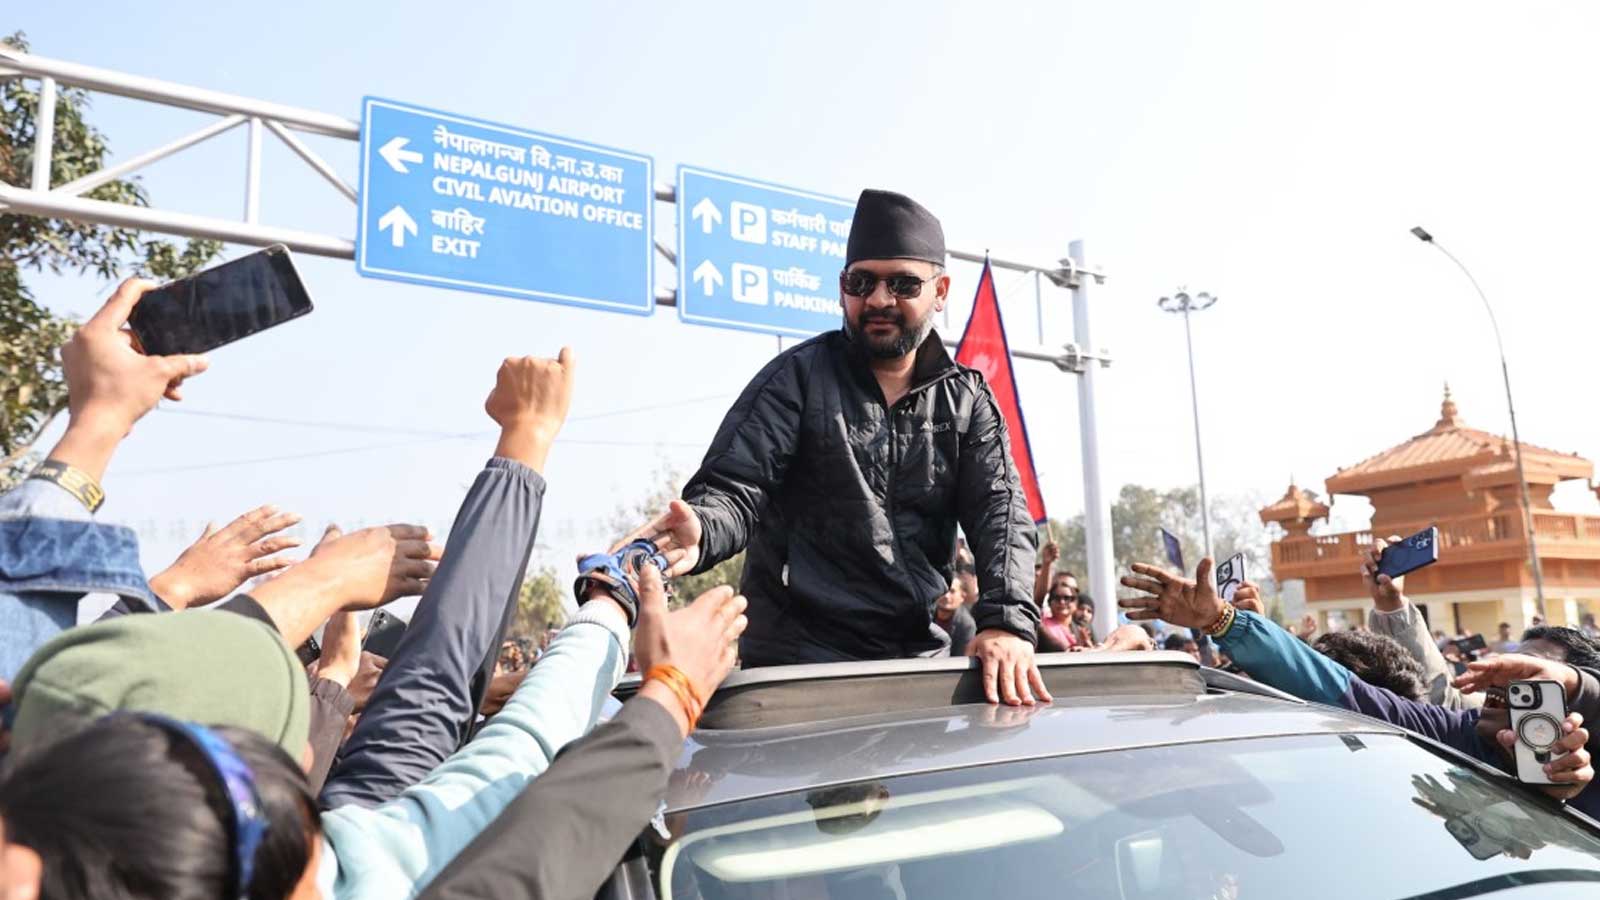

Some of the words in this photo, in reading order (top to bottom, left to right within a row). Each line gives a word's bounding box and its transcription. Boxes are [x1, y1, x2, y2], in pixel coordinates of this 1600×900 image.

[433, 152, 543, 193] NEPALGUNJ
[548, 175, 625, 205] AIRPORT
[432, 176, 484, 202] CIVIL
[488, 186, 578, 219] AVIATION
[582, 204, 643, 230] OFFICE
[431, 207, 486, 236] बाहिर
[431, 235, 480, 259] EXIT
[771, 230, 817, 252] STAFF
